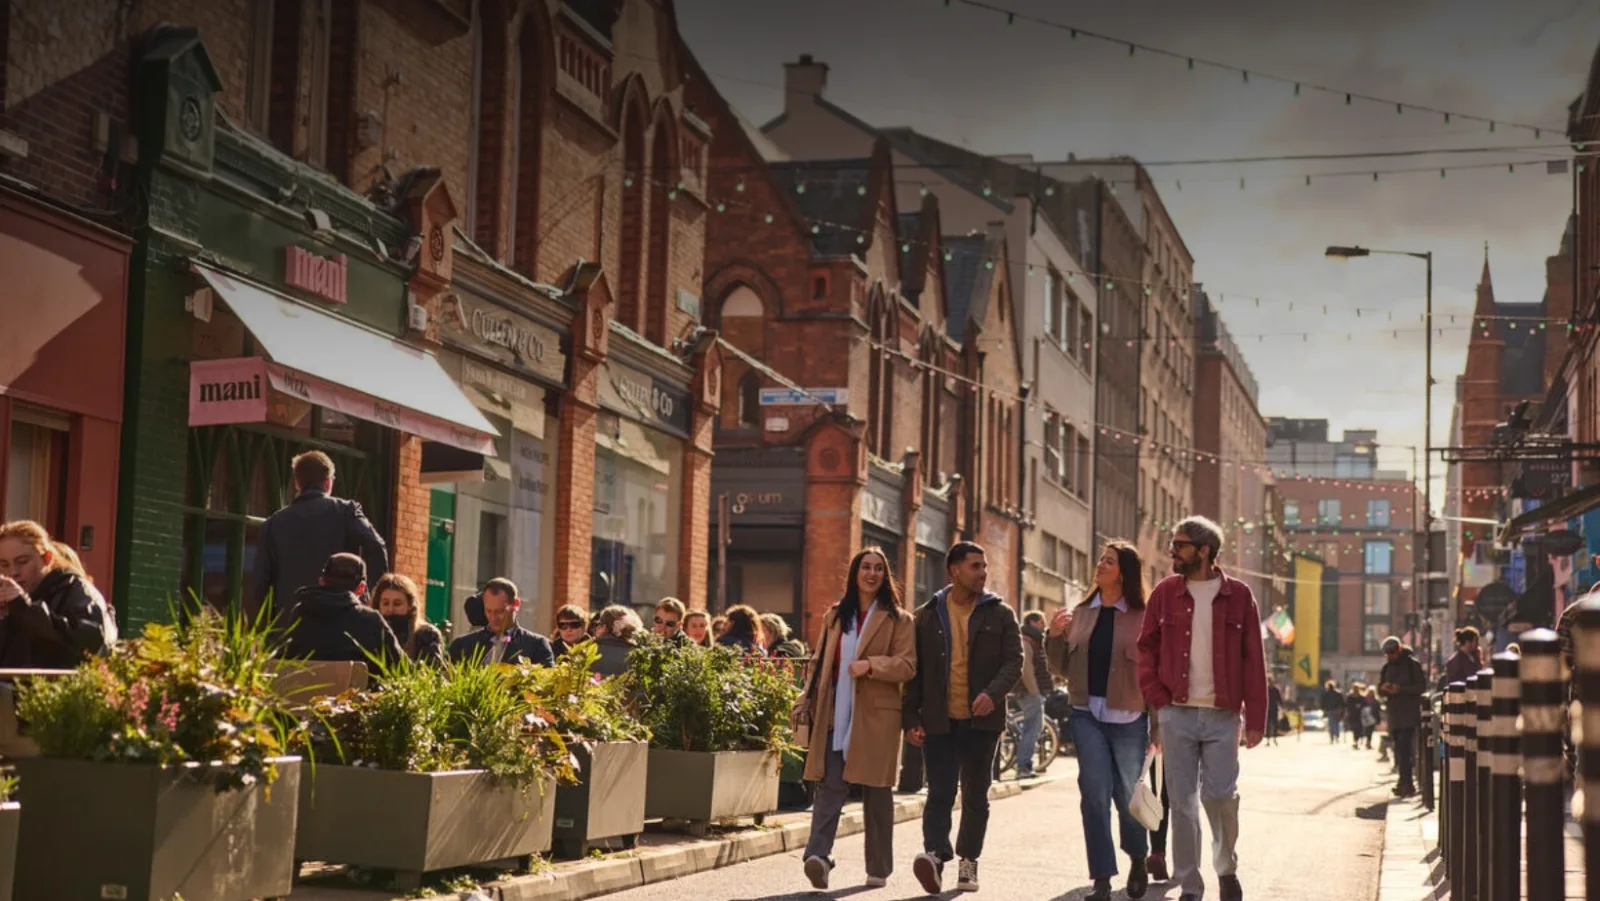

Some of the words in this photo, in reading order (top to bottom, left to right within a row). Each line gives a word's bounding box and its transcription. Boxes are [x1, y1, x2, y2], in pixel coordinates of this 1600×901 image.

[286, 245, 347, 304] mani
[200, 365, 261, 402] mani
[1551, 472, 1570, 488] 27
